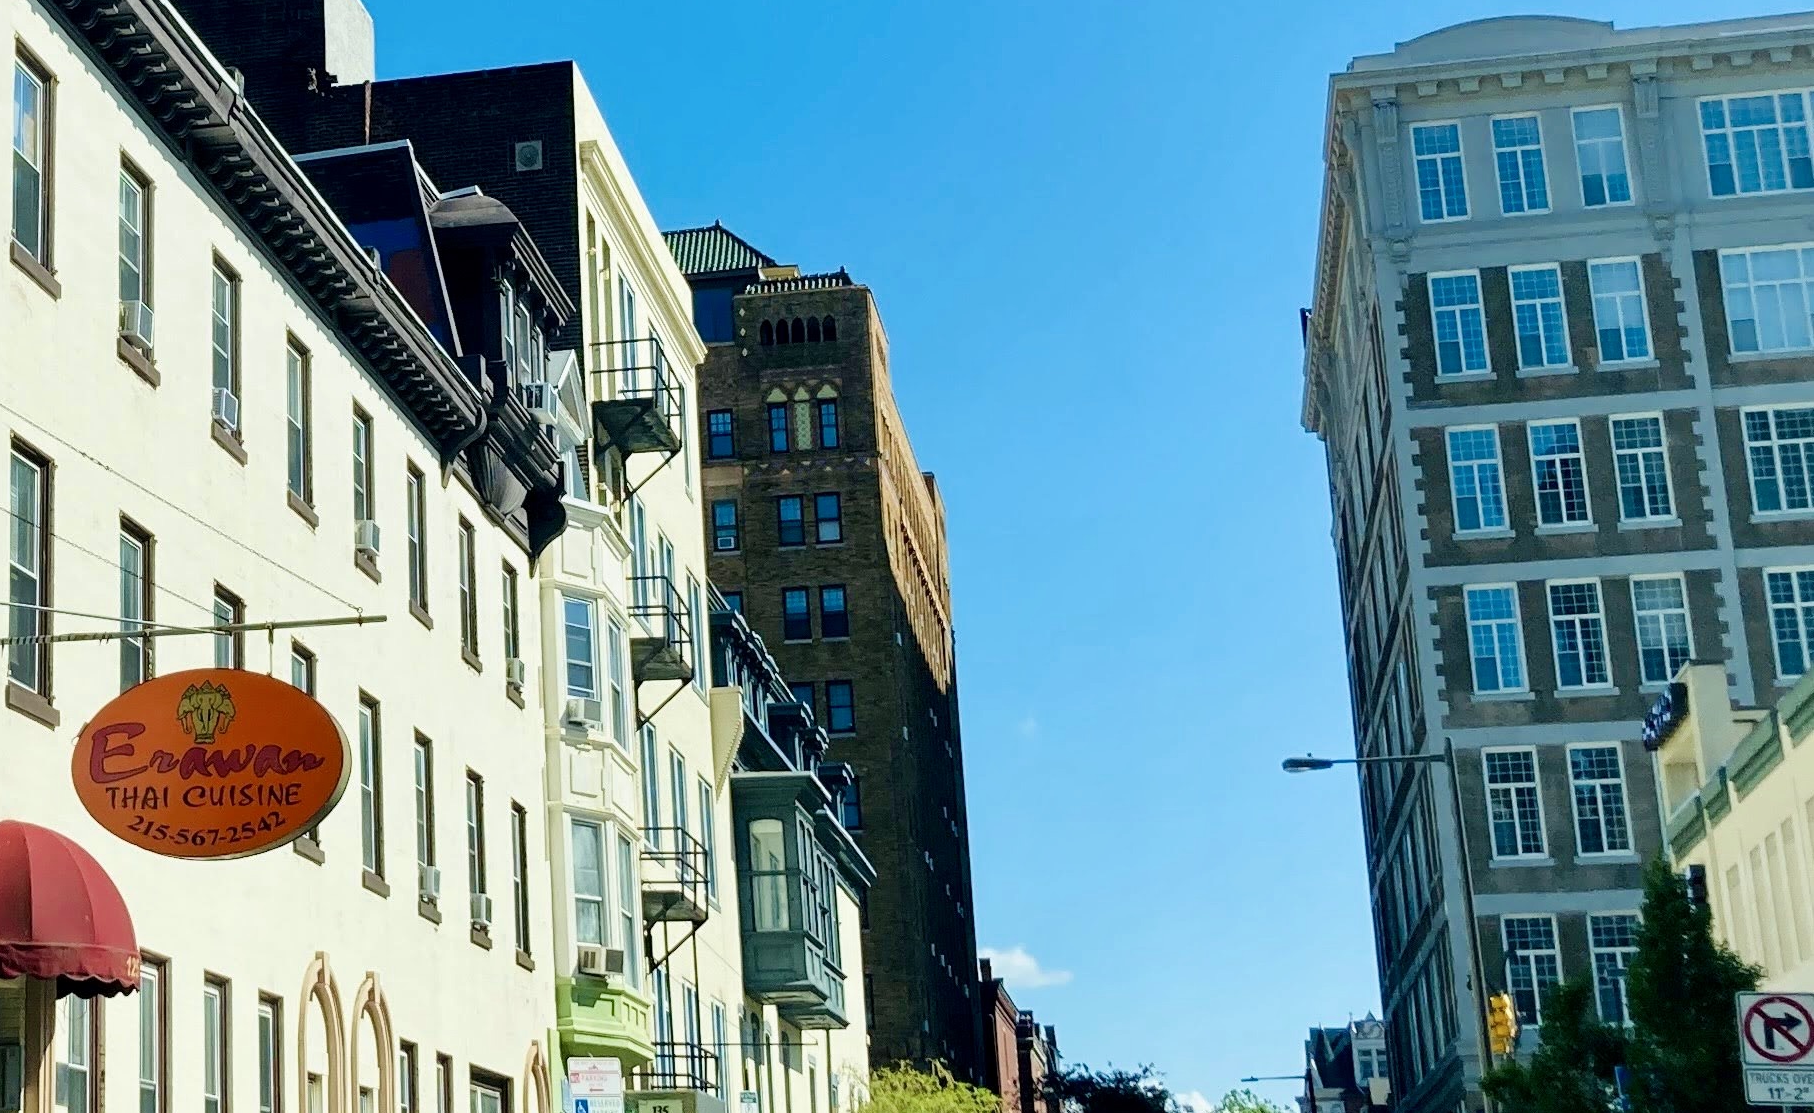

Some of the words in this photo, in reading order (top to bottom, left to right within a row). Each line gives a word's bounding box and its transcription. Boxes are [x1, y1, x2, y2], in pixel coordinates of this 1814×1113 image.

[89, 722, 325, 784] Erawan
[106, 786, 169, 810] THAI
[182, 783, 302, 809] CUISINE
[127, 811, 289, 847] 215-567-2542
[1749, 1072, 1790, 1084] TRUCKS
[1792, 1073, 1814, 1085] OVE
